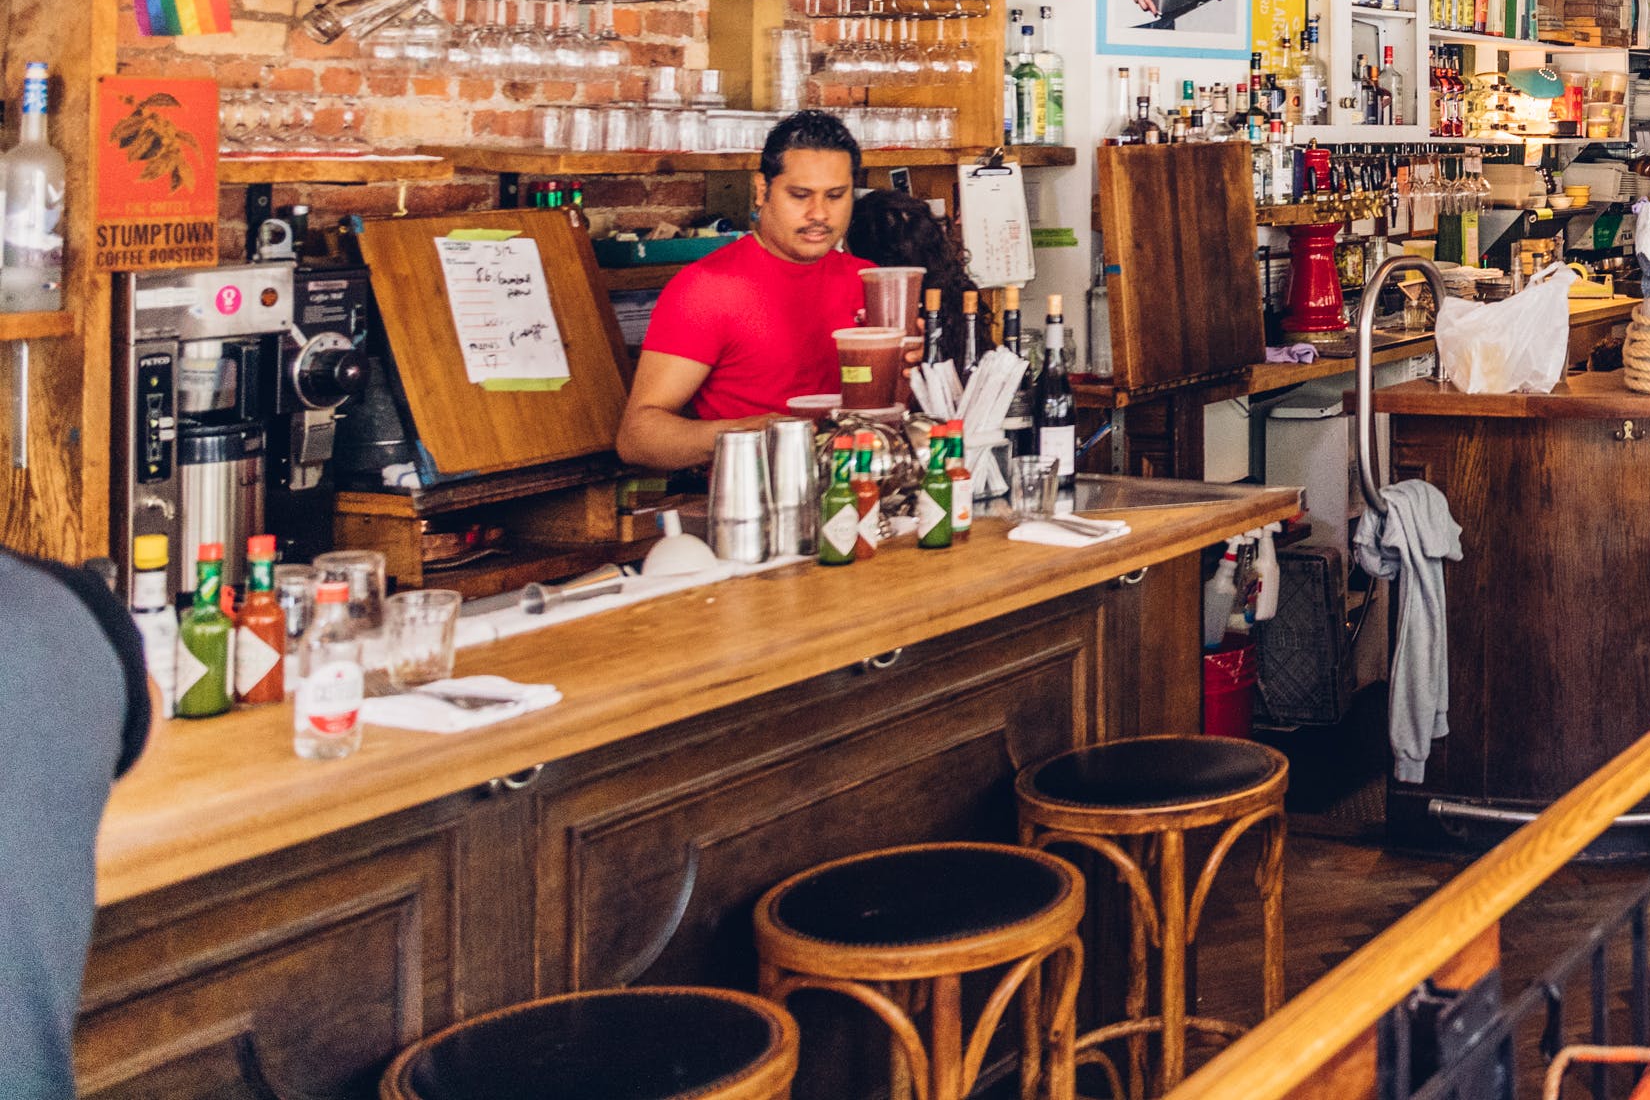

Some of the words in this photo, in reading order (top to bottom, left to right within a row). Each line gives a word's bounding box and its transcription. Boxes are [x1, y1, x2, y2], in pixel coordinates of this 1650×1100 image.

[96, 222, 214, 247] STUMPTOWN
[96, 250, 144, 267] COFFEE
[149, 247, 214, 264] ROASTERS
